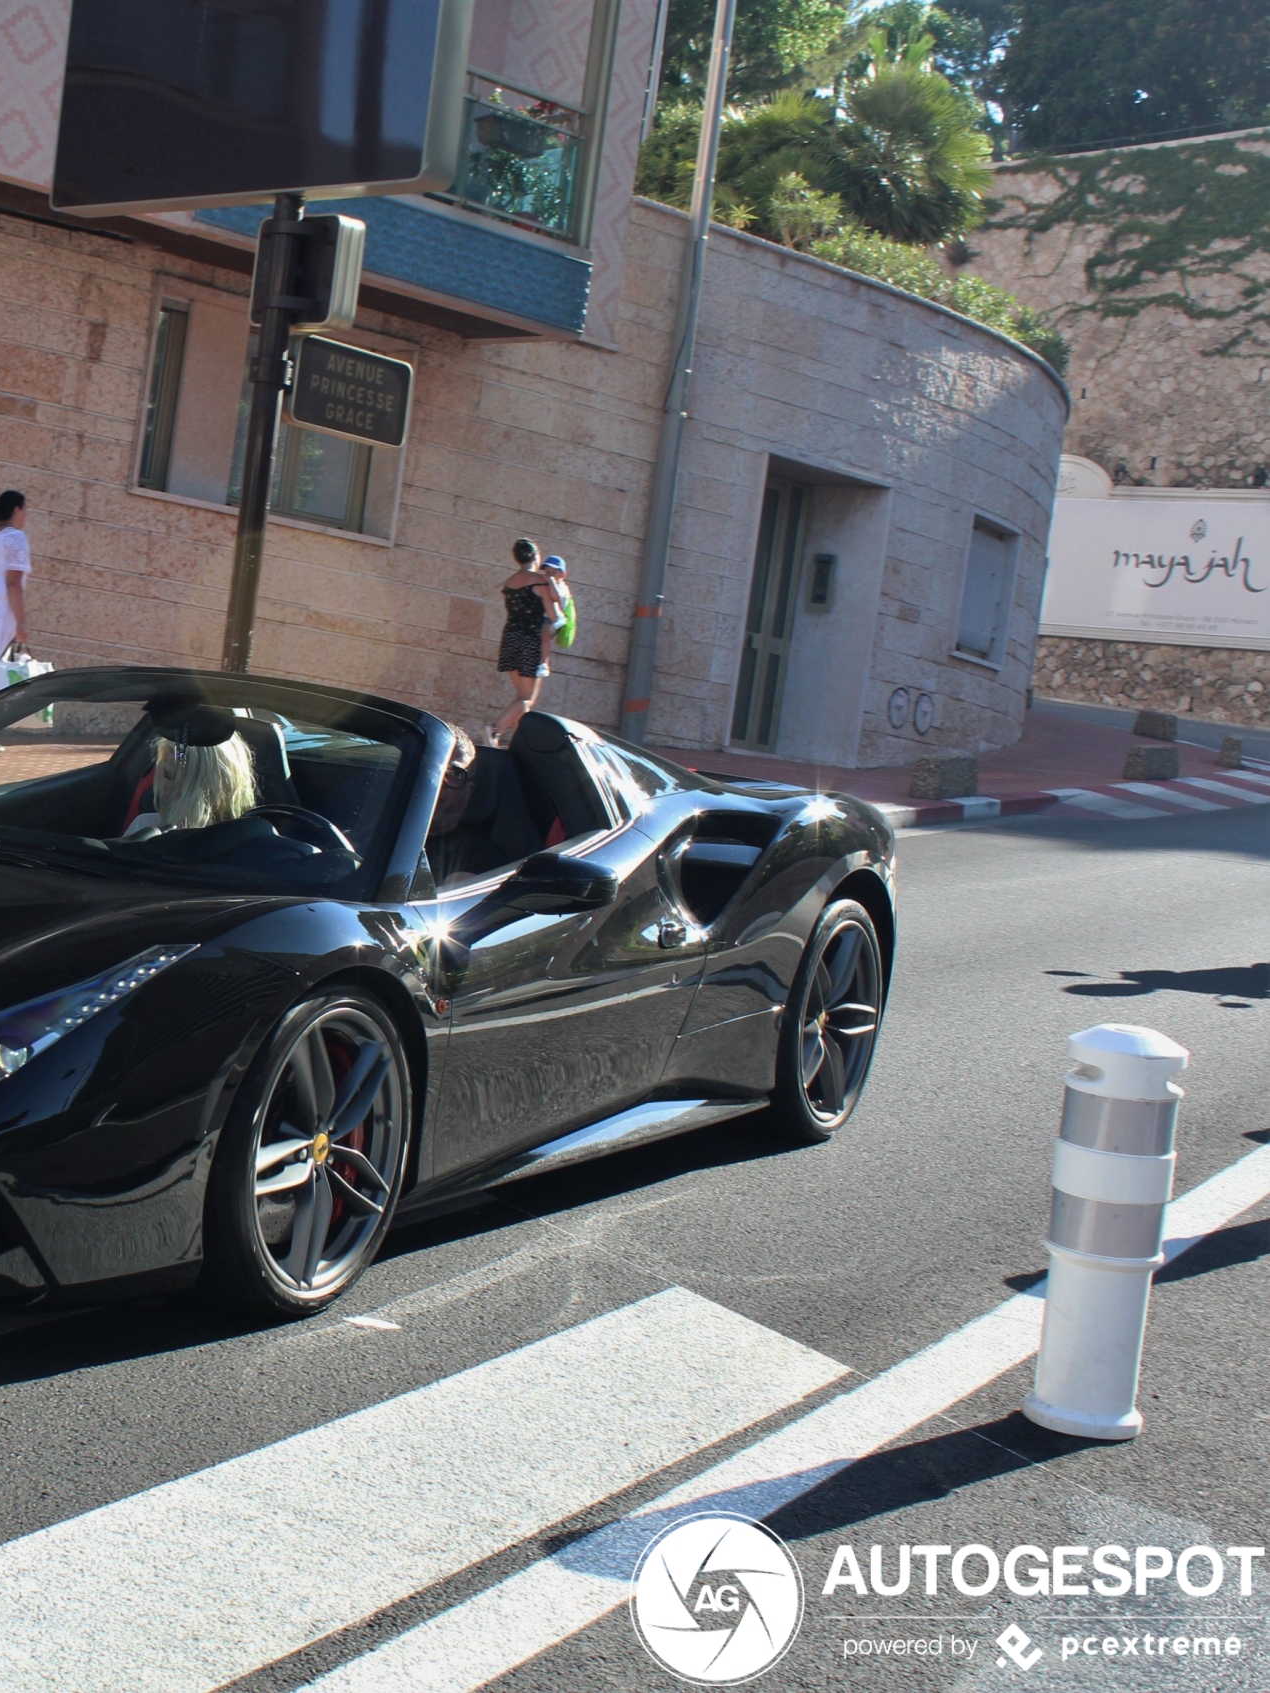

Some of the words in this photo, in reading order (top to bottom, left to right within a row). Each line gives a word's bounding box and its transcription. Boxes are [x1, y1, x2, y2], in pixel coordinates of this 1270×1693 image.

[327, 355, 385, 385] AVENUE
[309, 374, 395, 412] PRINCESSE
[325, 402, 374, 430] GRACE
